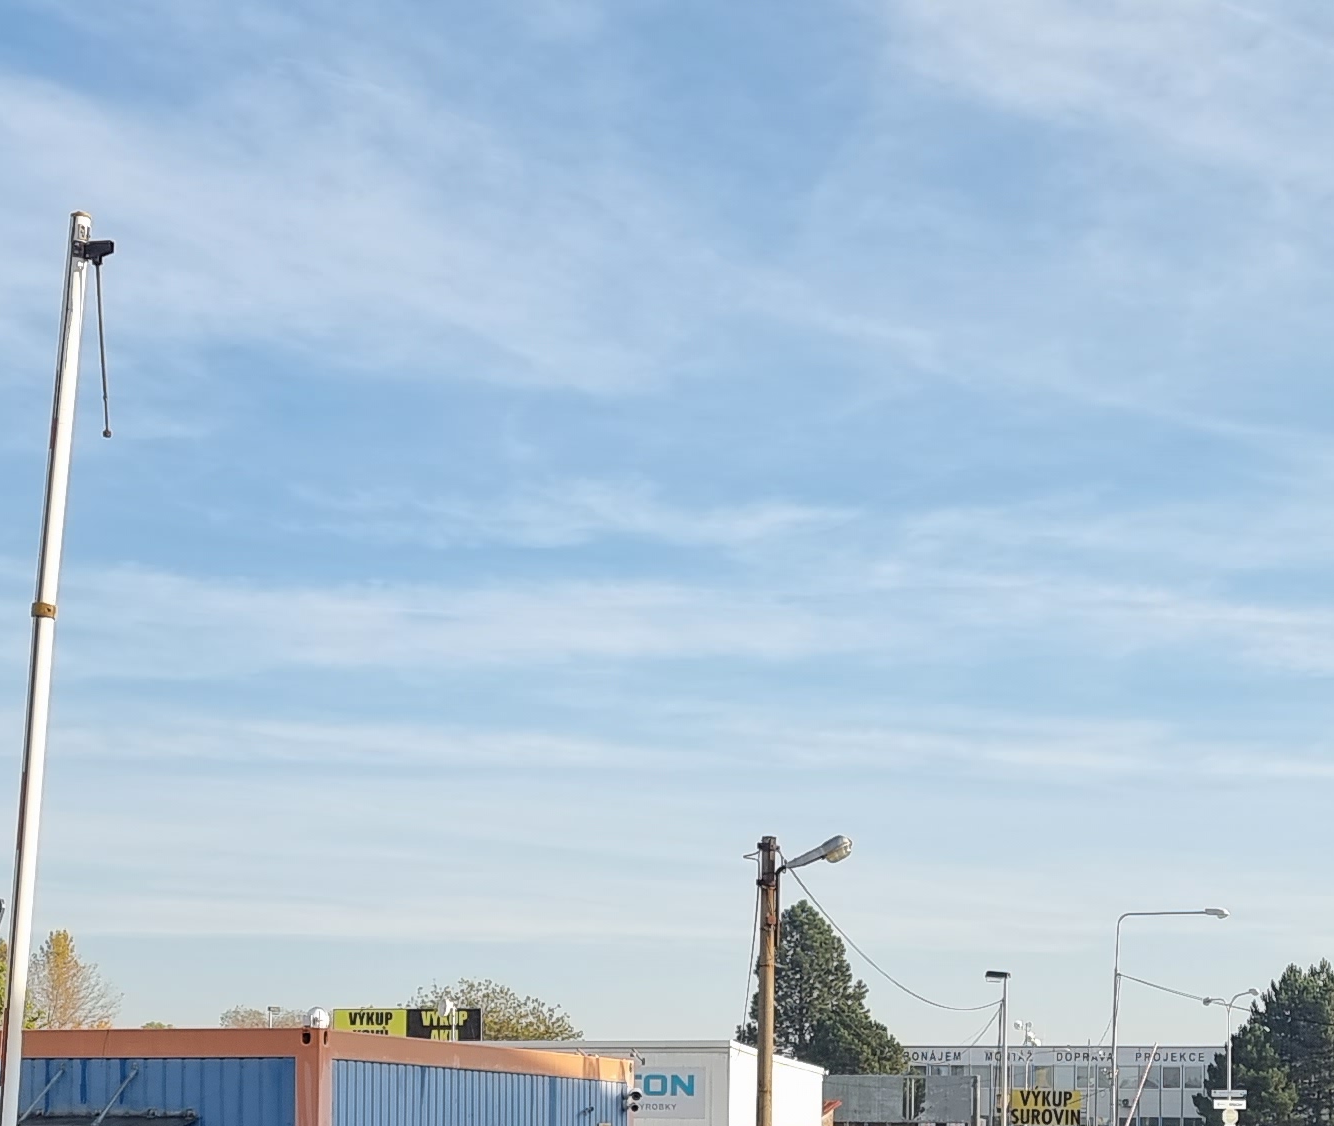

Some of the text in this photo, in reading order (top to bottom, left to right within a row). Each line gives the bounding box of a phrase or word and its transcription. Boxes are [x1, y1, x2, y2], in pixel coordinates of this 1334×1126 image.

[1135, 1052, 1205, 1062] PROJEKCE
[634, 1074, 695, 1096] ON
[1020, 1086, 1072, 1107] VÝKUP
[1011, 1108, 1080, 1126] SUROVIN
